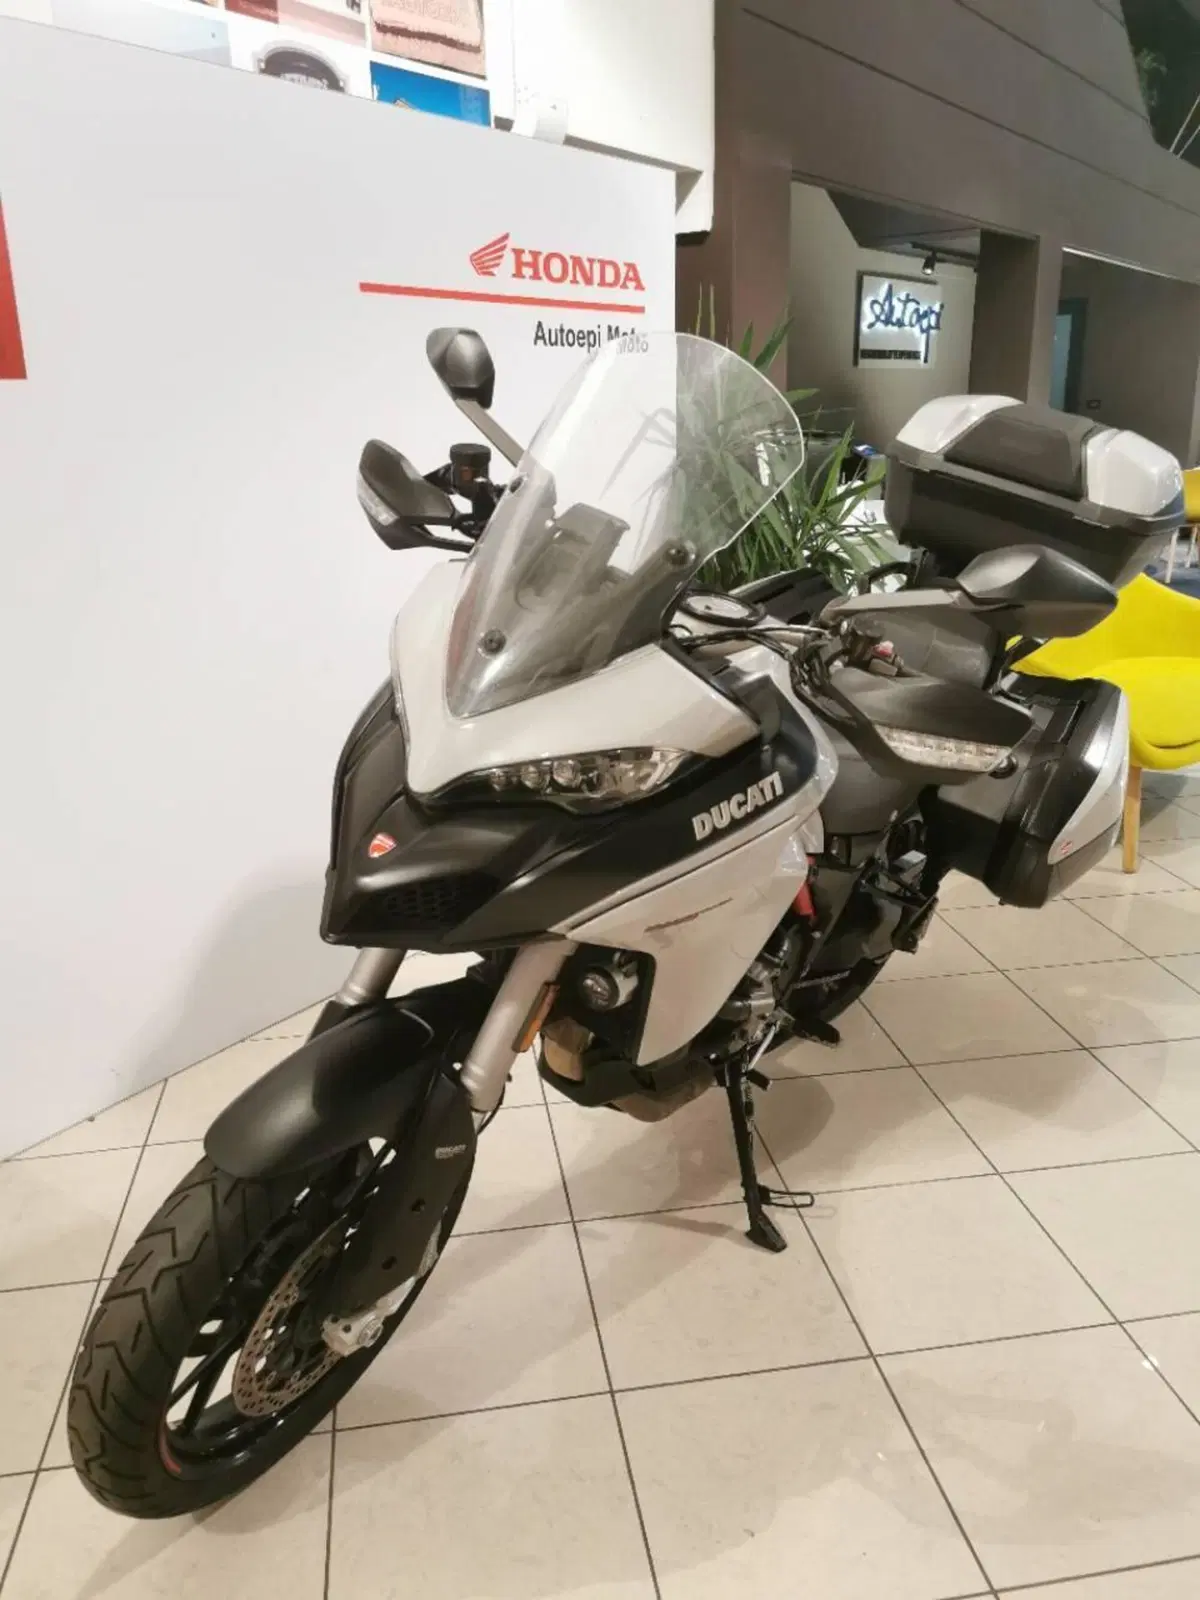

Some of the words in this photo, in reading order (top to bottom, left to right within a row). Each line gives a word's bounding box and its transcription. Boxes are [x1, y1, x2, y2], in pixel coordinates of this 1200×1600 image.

[511, 248, 645, 291] HONDA
[533, 321, 601, 353] Autoepi
[692, 771, 783, 841] DUCATI
